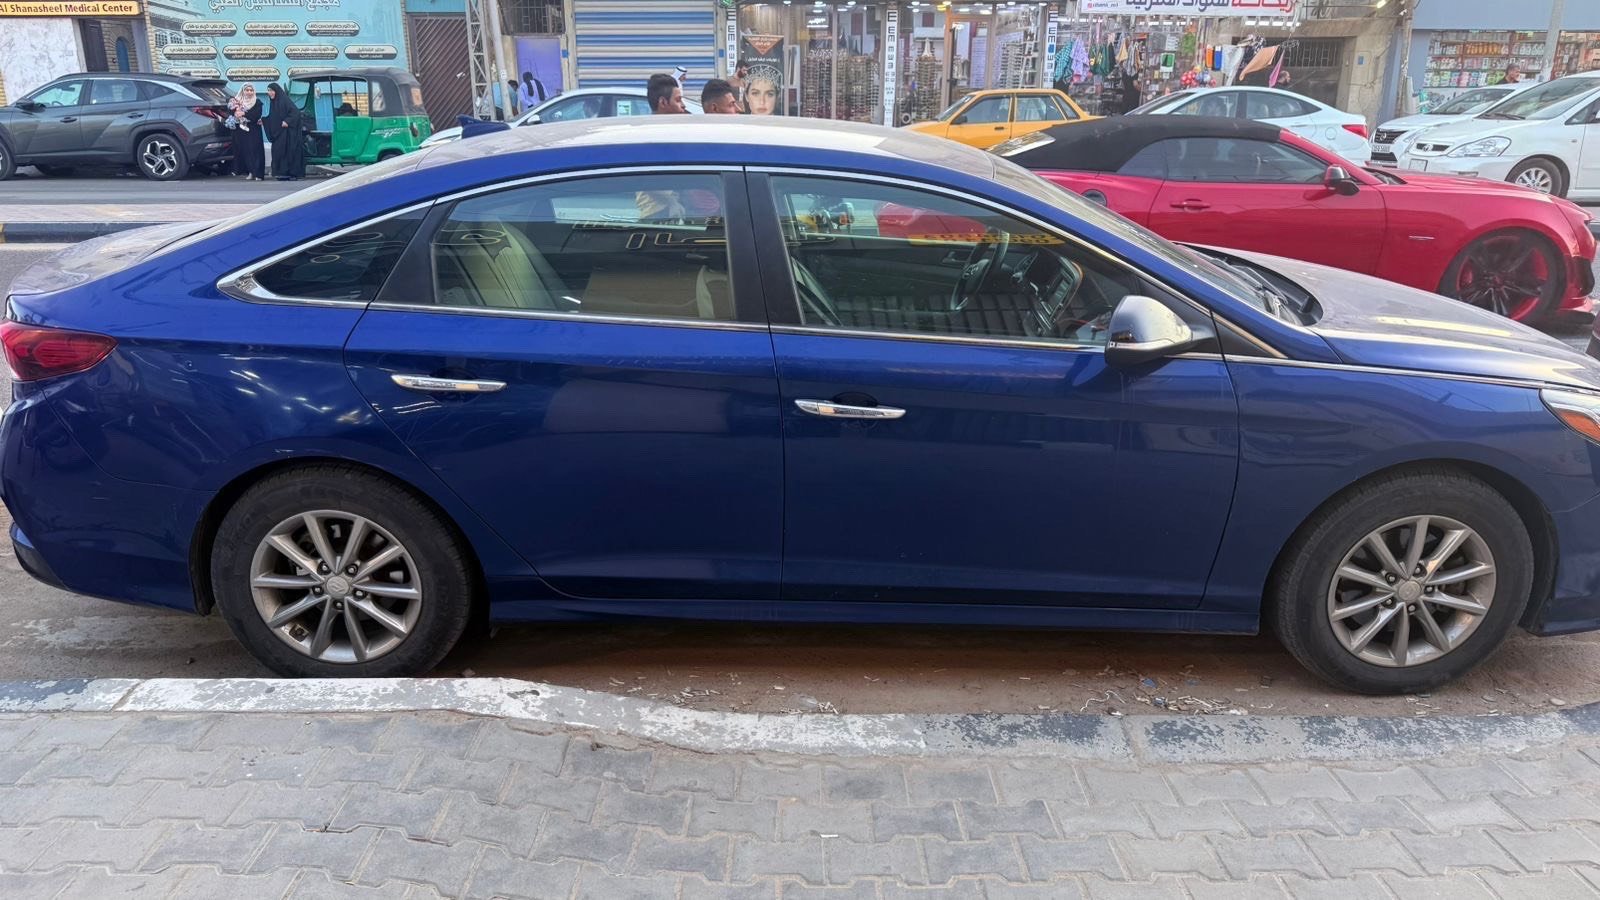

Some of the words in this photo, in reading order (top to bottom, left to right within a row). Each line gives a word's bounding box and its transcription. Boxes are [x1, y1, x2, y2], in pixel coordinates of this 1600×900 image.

[0, 4, 7, 13] Al
[11, 4, 63, 13] Shanasheel
[65, 4, 100, 13] Medical
[102, 3, 134, 12] Center
